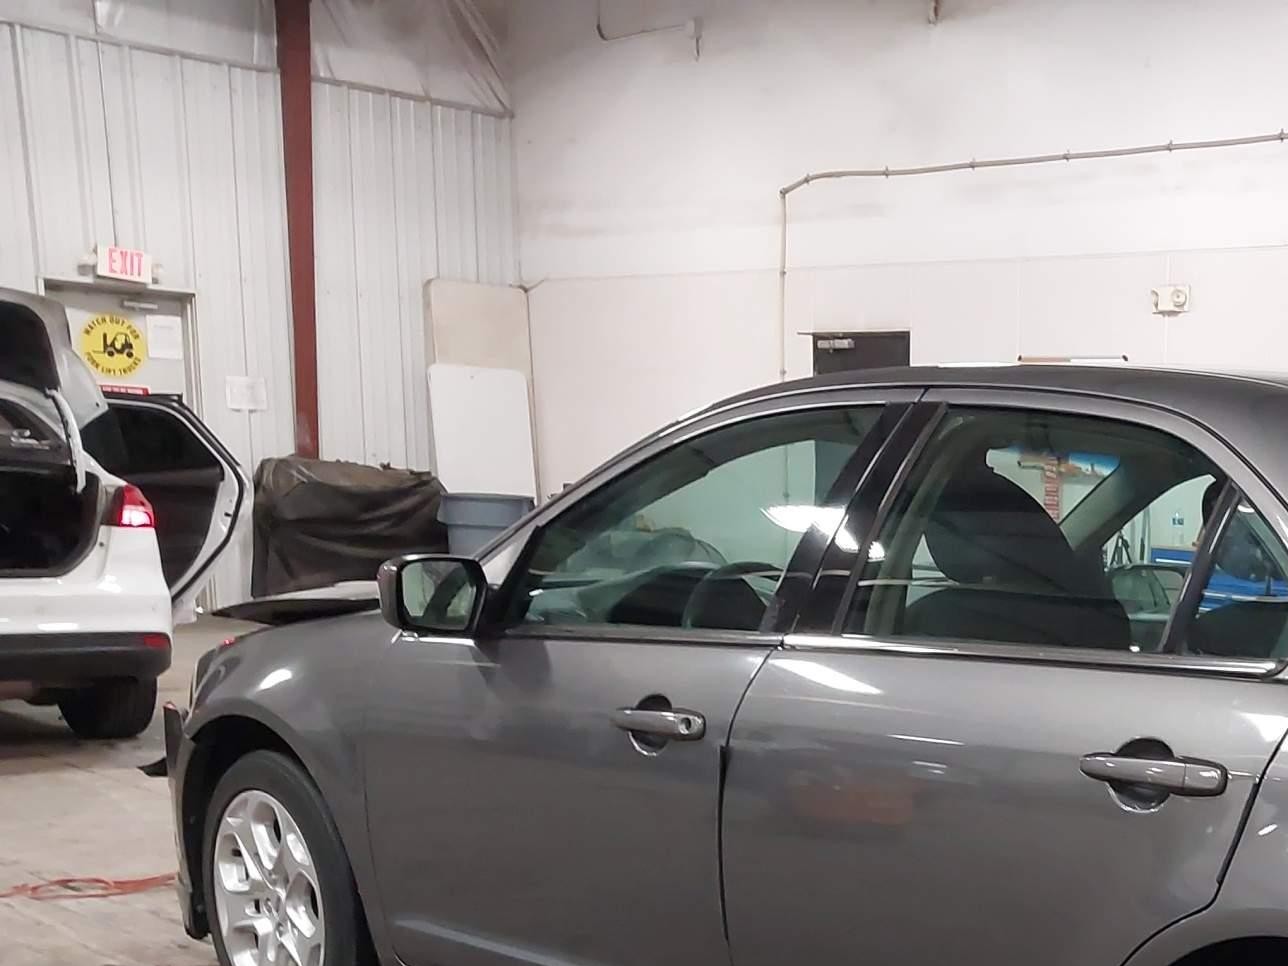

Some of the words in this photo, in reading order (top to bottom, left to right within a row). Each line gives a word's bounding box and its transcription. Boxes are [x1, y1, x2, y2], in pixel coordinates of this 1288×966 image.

[108, 247, 144, 277] EXIT
[84, 315, 107, 336] WATCH
[109, 315, 125, 327] OUT
[126, 324, 140, 340] FOR
